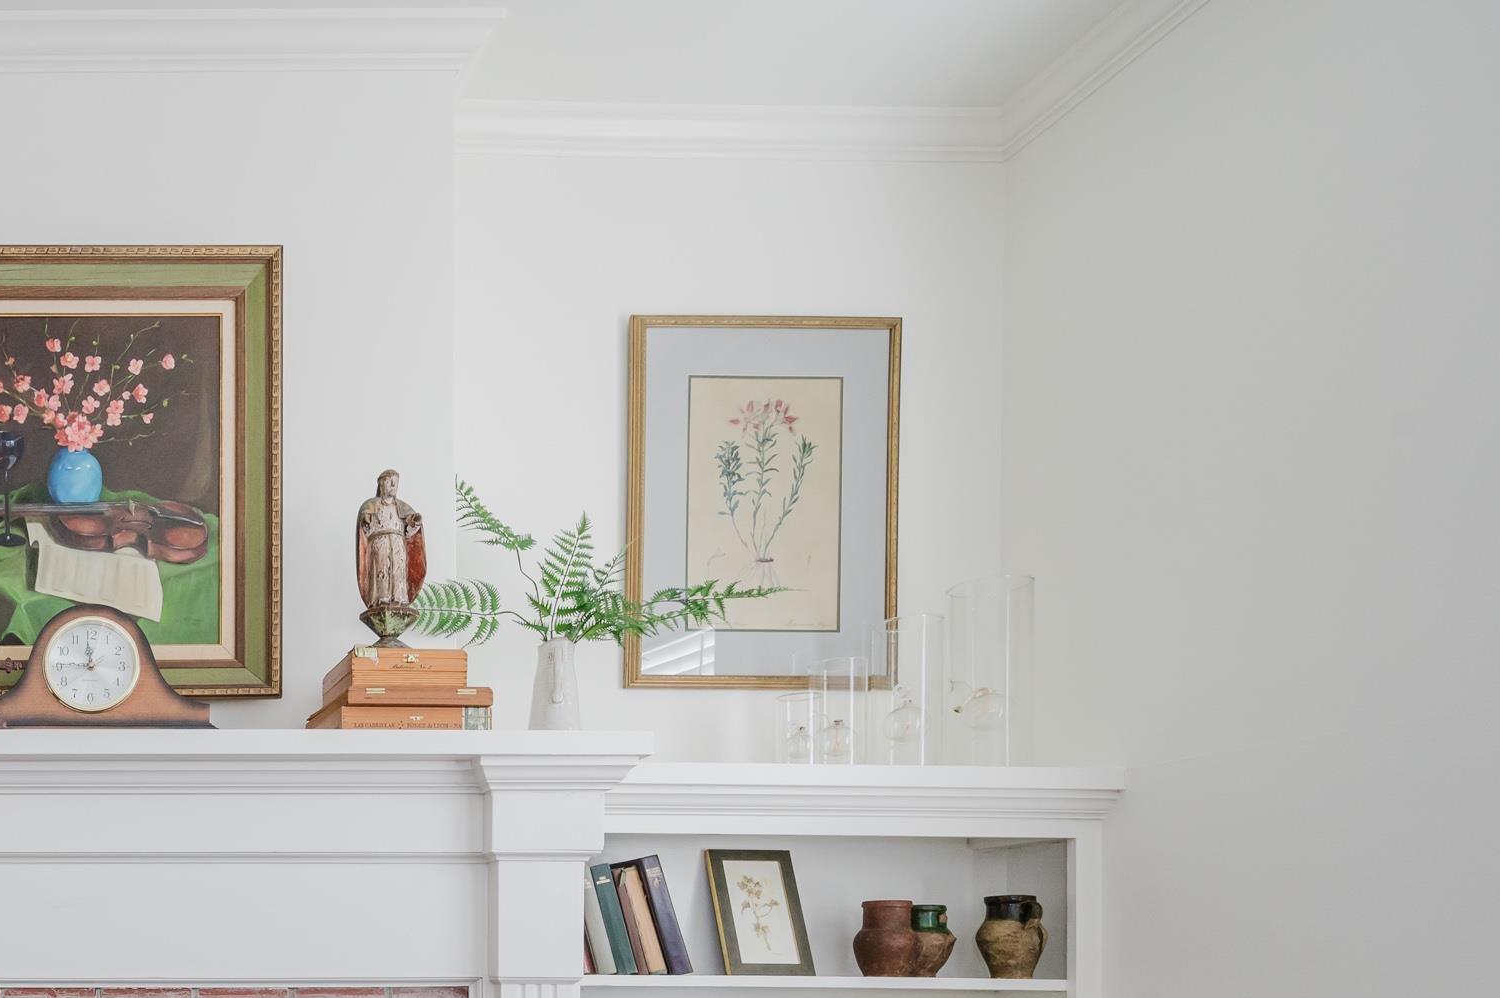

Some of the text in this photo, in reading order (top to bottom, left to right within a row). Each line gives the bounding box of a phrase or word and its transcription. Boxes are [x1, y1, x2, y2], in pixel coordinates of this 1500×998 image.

[71, 634, 79, 645] 11
[86, 630, 98, 641] 12
[58, 646, 70, 657] 10
[114, 646, 122, 656] 2
[117, 661, 126, 672] 3
[60, 676, 68, 687] 8
[71, 688, 78, 699] 7
[86, 693, 94, 704] 6
[103, 688, 110, 700] 5
